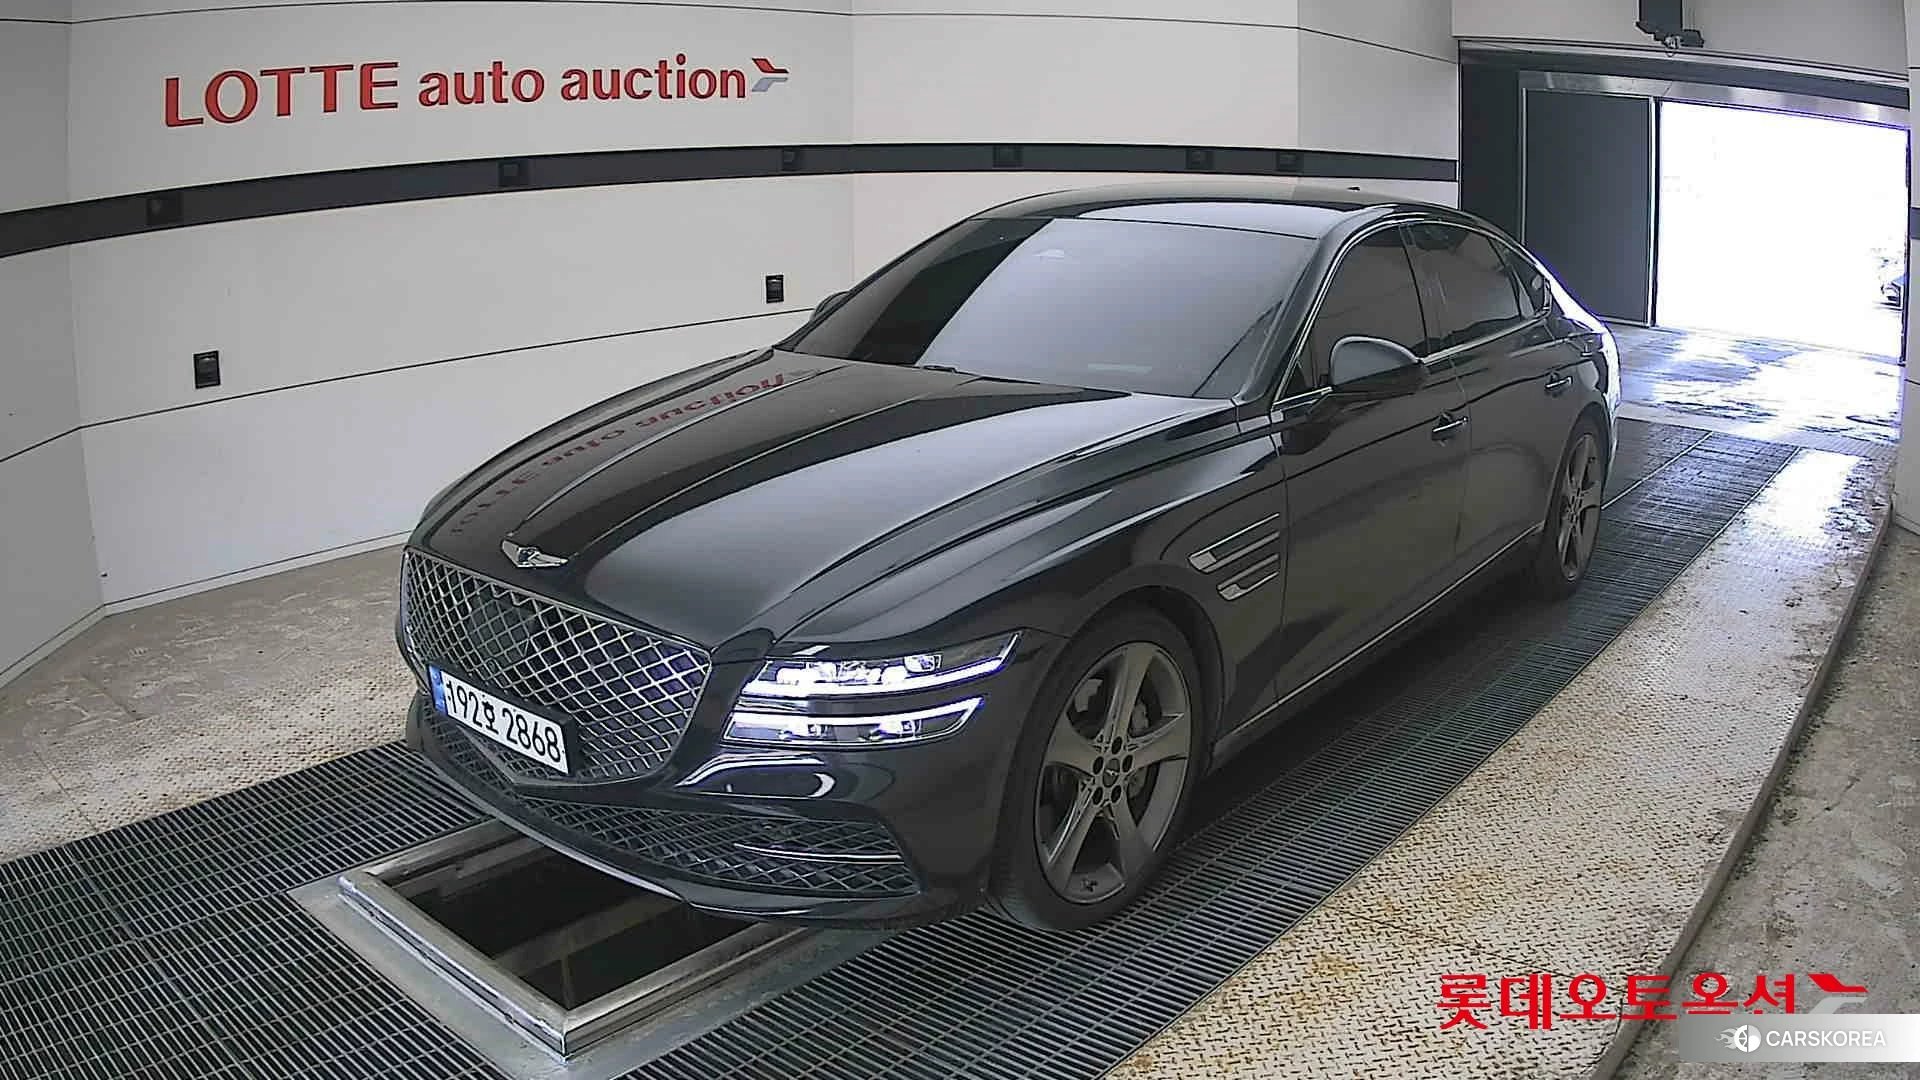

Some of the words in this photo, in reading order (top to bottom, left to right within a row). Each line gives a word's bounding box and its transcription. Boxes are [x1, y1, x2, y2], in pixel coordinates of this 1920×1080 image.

[165, 62, 399, 127] LOTTE
[418, 60, 545, 107] auto
[560, 52, 746, 101] auction
[446, 680, 500, 734] 192호
[502, 707, 561, 763] 2868
